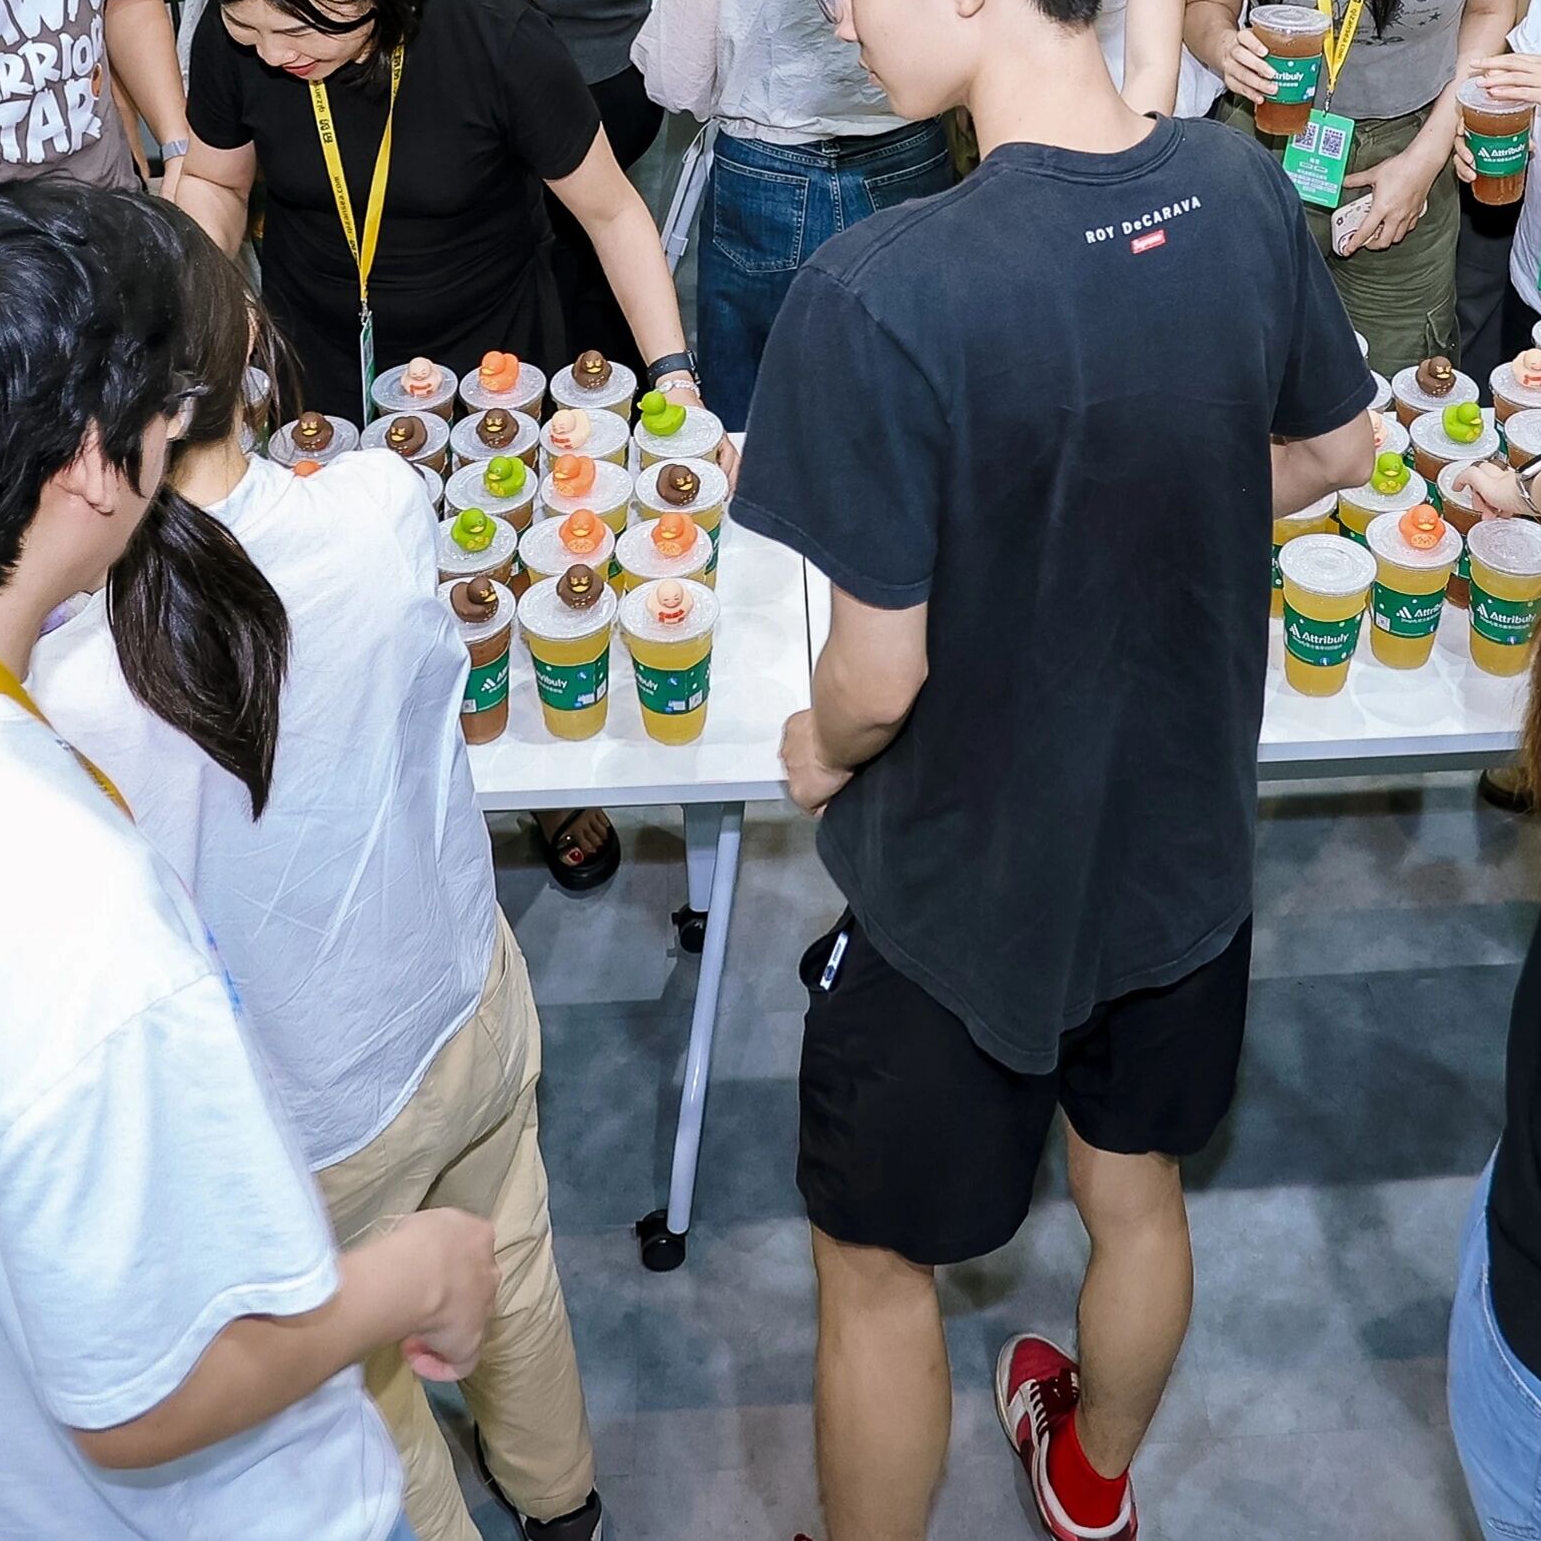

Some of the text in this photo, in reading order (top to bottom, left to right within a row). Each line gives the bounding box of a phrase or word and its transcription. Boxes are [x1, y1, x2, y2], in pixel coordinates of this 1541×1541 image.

[1274, 71, 1304, 82] tribuly
[1491, 143, 1525, 158] Attribuly
[1084, 195, 1202, 244] ROY DeCARAVA
[1301, 631, 1350, 646] Attribuly
